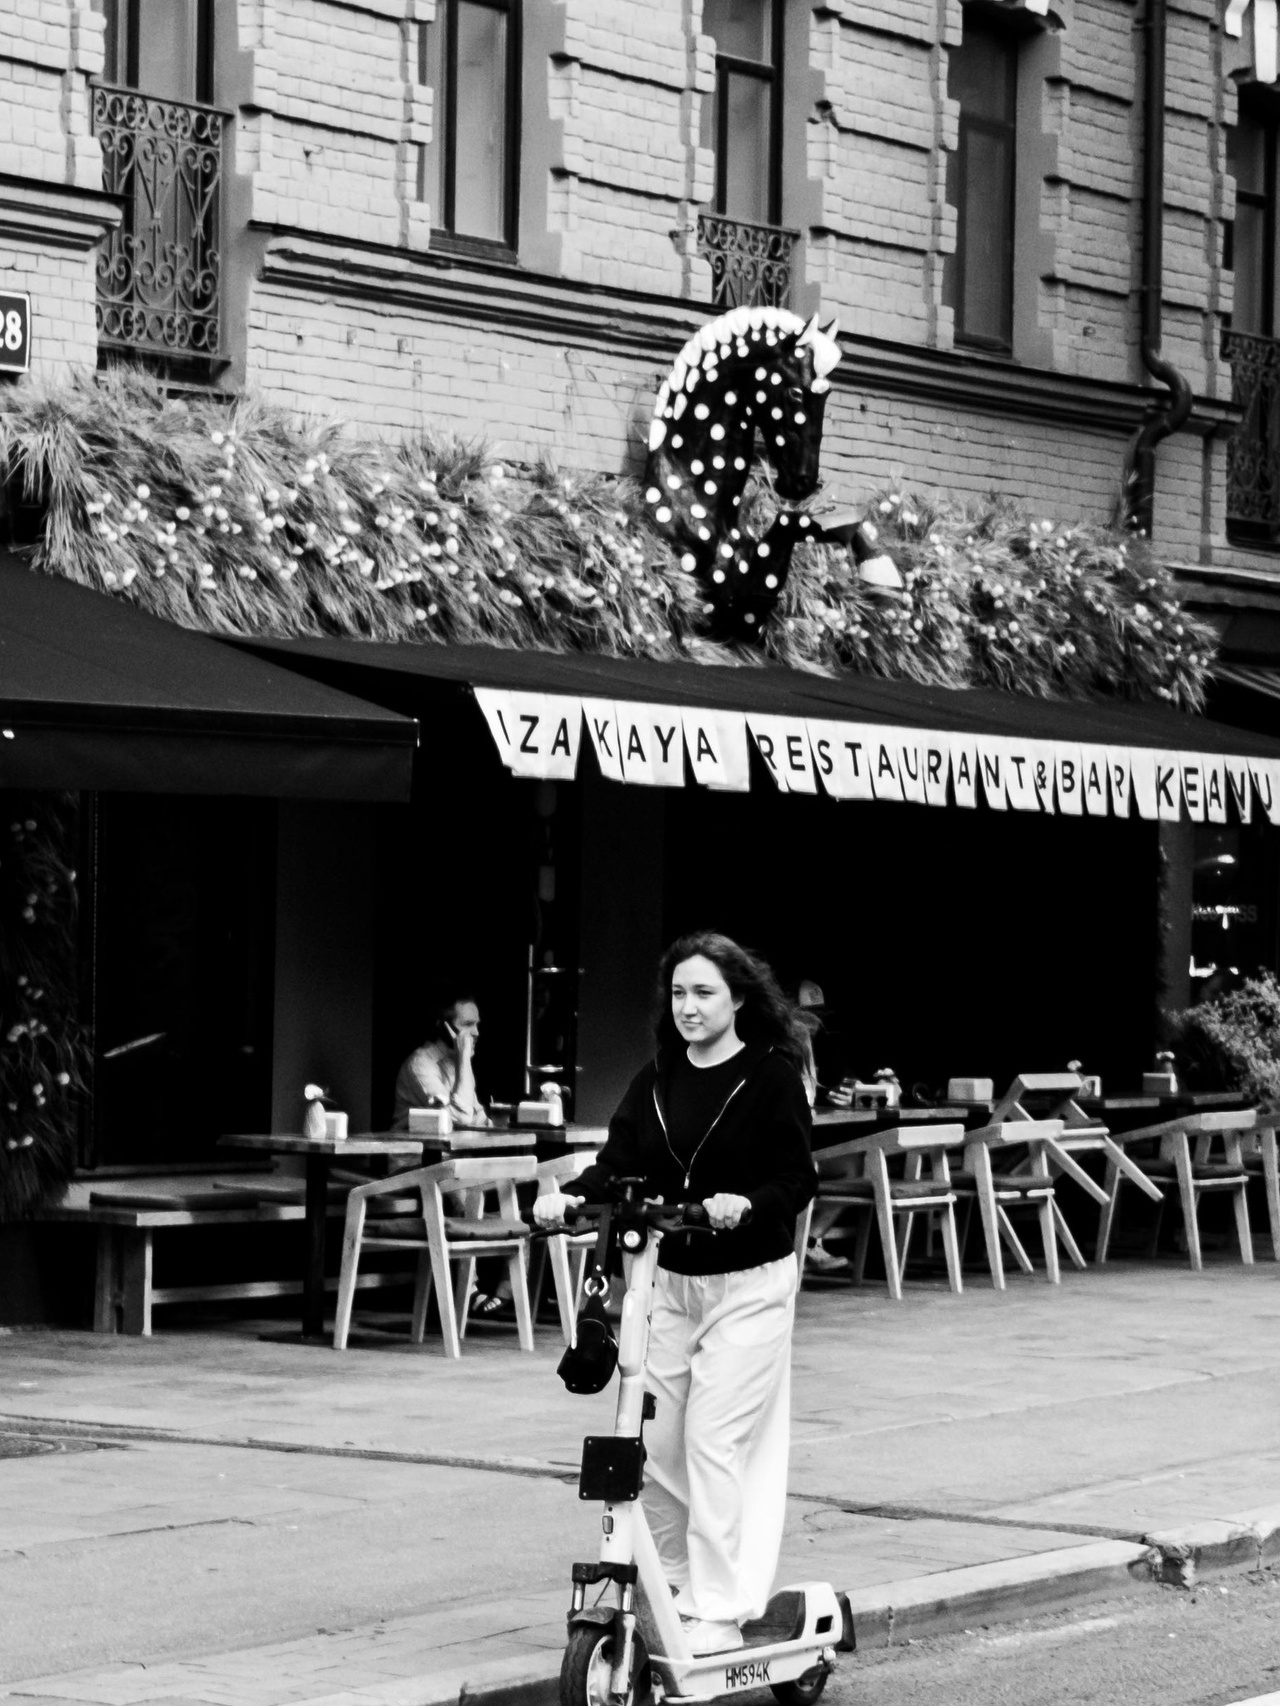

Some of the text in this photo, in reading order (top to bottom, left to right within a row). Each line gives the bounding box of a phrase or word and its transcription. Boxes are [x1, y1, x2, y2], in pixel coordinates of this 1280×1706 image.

[496, 709, 718, 764] IZAKAYA
[755, 734, 1125, 799] RESTAURANT&BAR
[725, 1660, 771, 1689] HM594K
